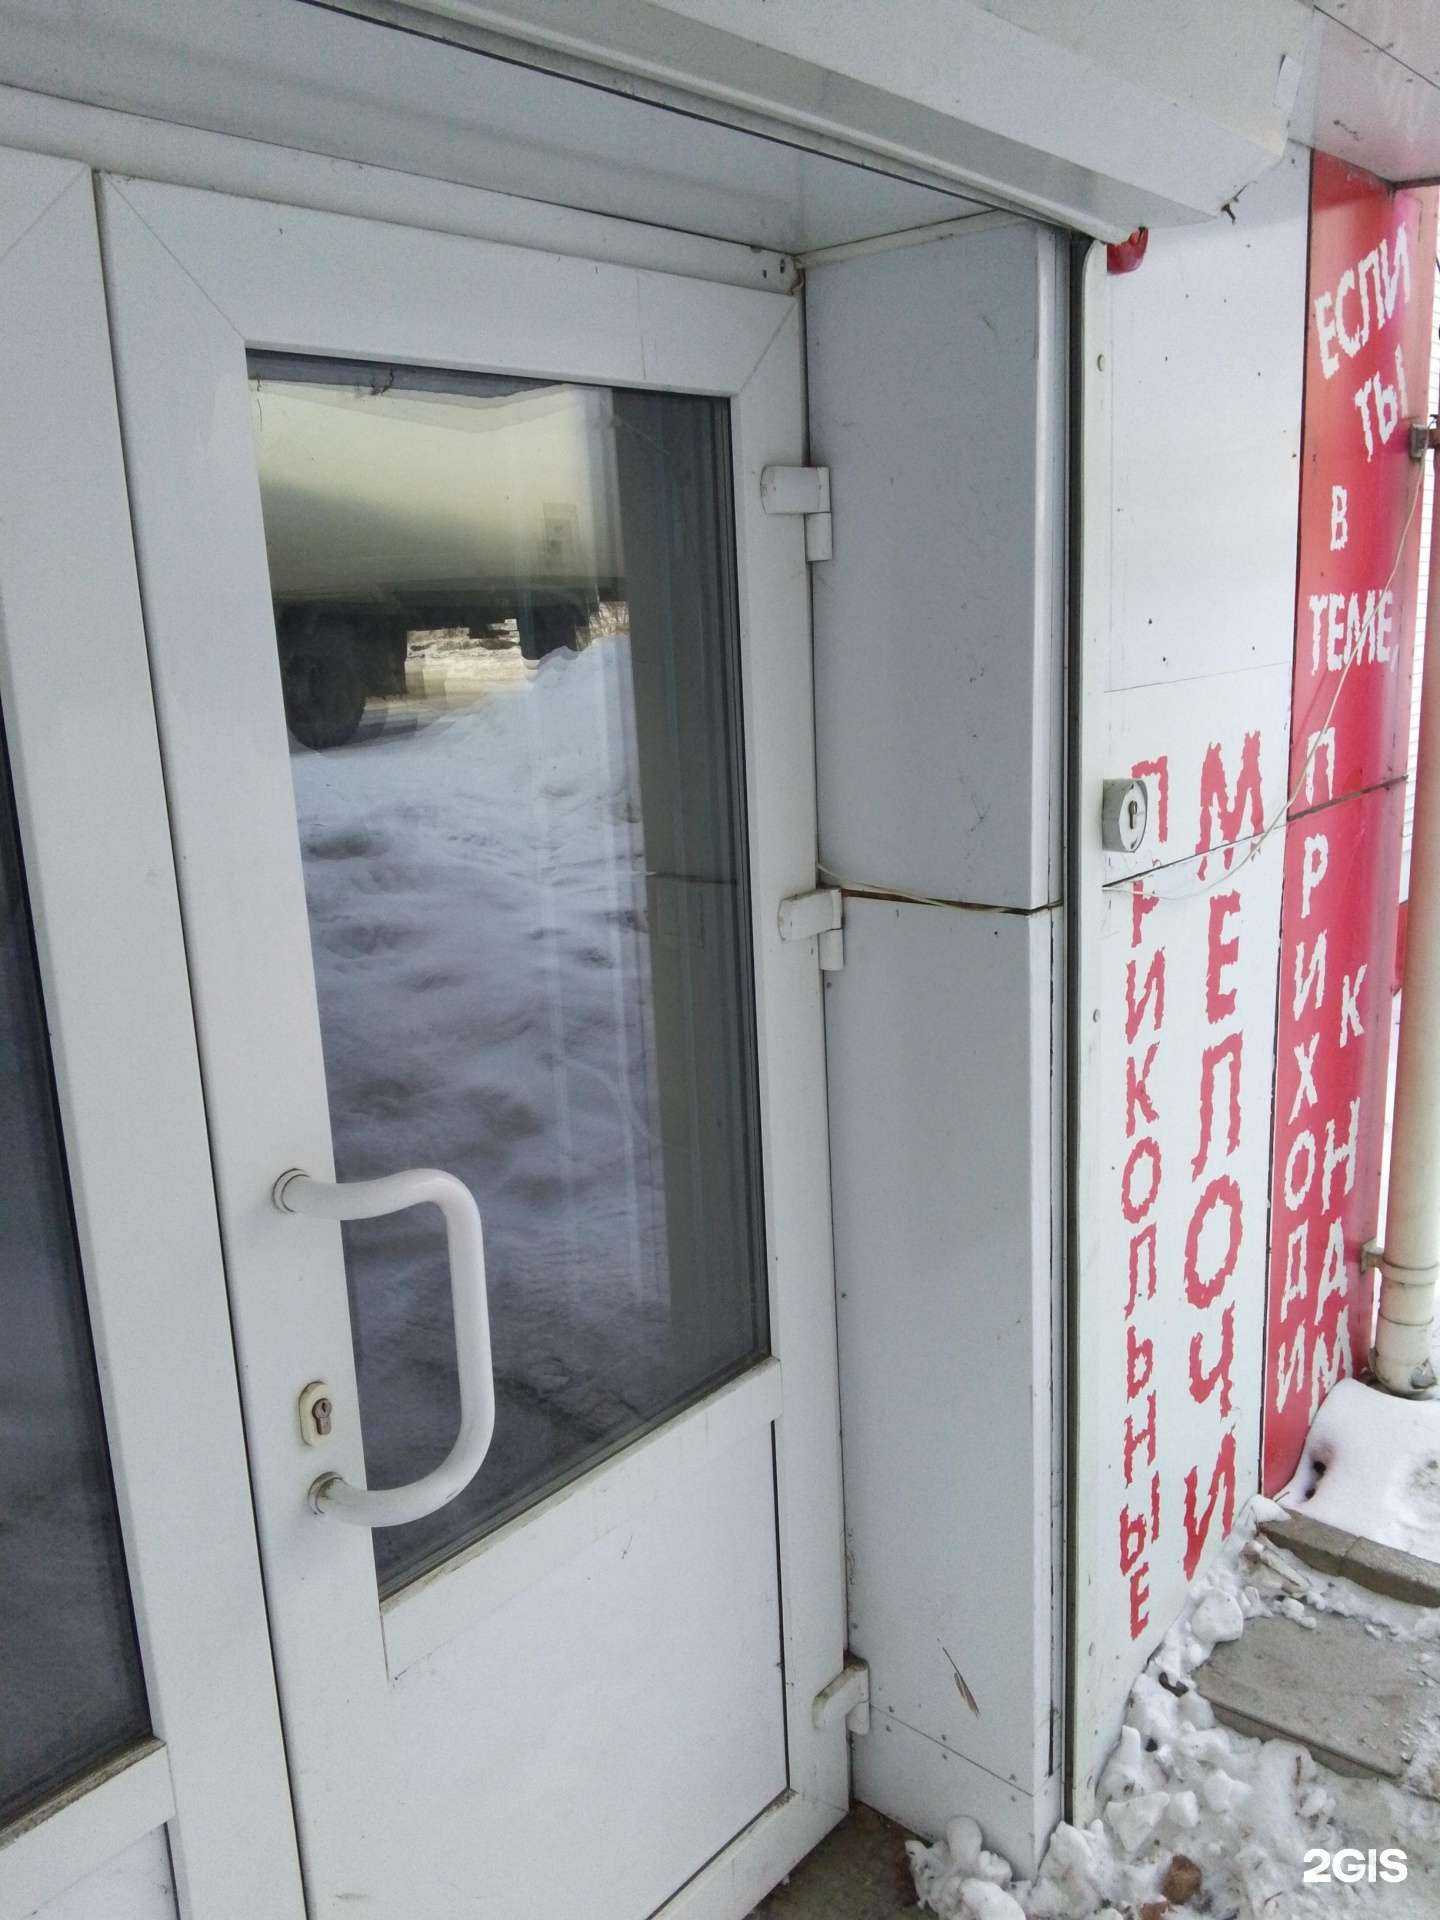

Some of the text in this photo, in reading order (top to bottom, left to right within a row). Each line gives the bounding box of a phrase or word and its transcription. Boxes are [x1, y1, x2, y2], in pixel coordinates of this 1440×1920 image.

[1314, 221, 1411, 379] ЕСЛИ
[1354, 343, 1408, 463] ТЫ
[1330, 485, 1348, 551] В
[1183, 730, 1264, 1581] МЕЛОЧИ
[1276, 726, 1336, 1414] ПРИХОДИ
[1309, 964, 1367, 1426] К НАМ
